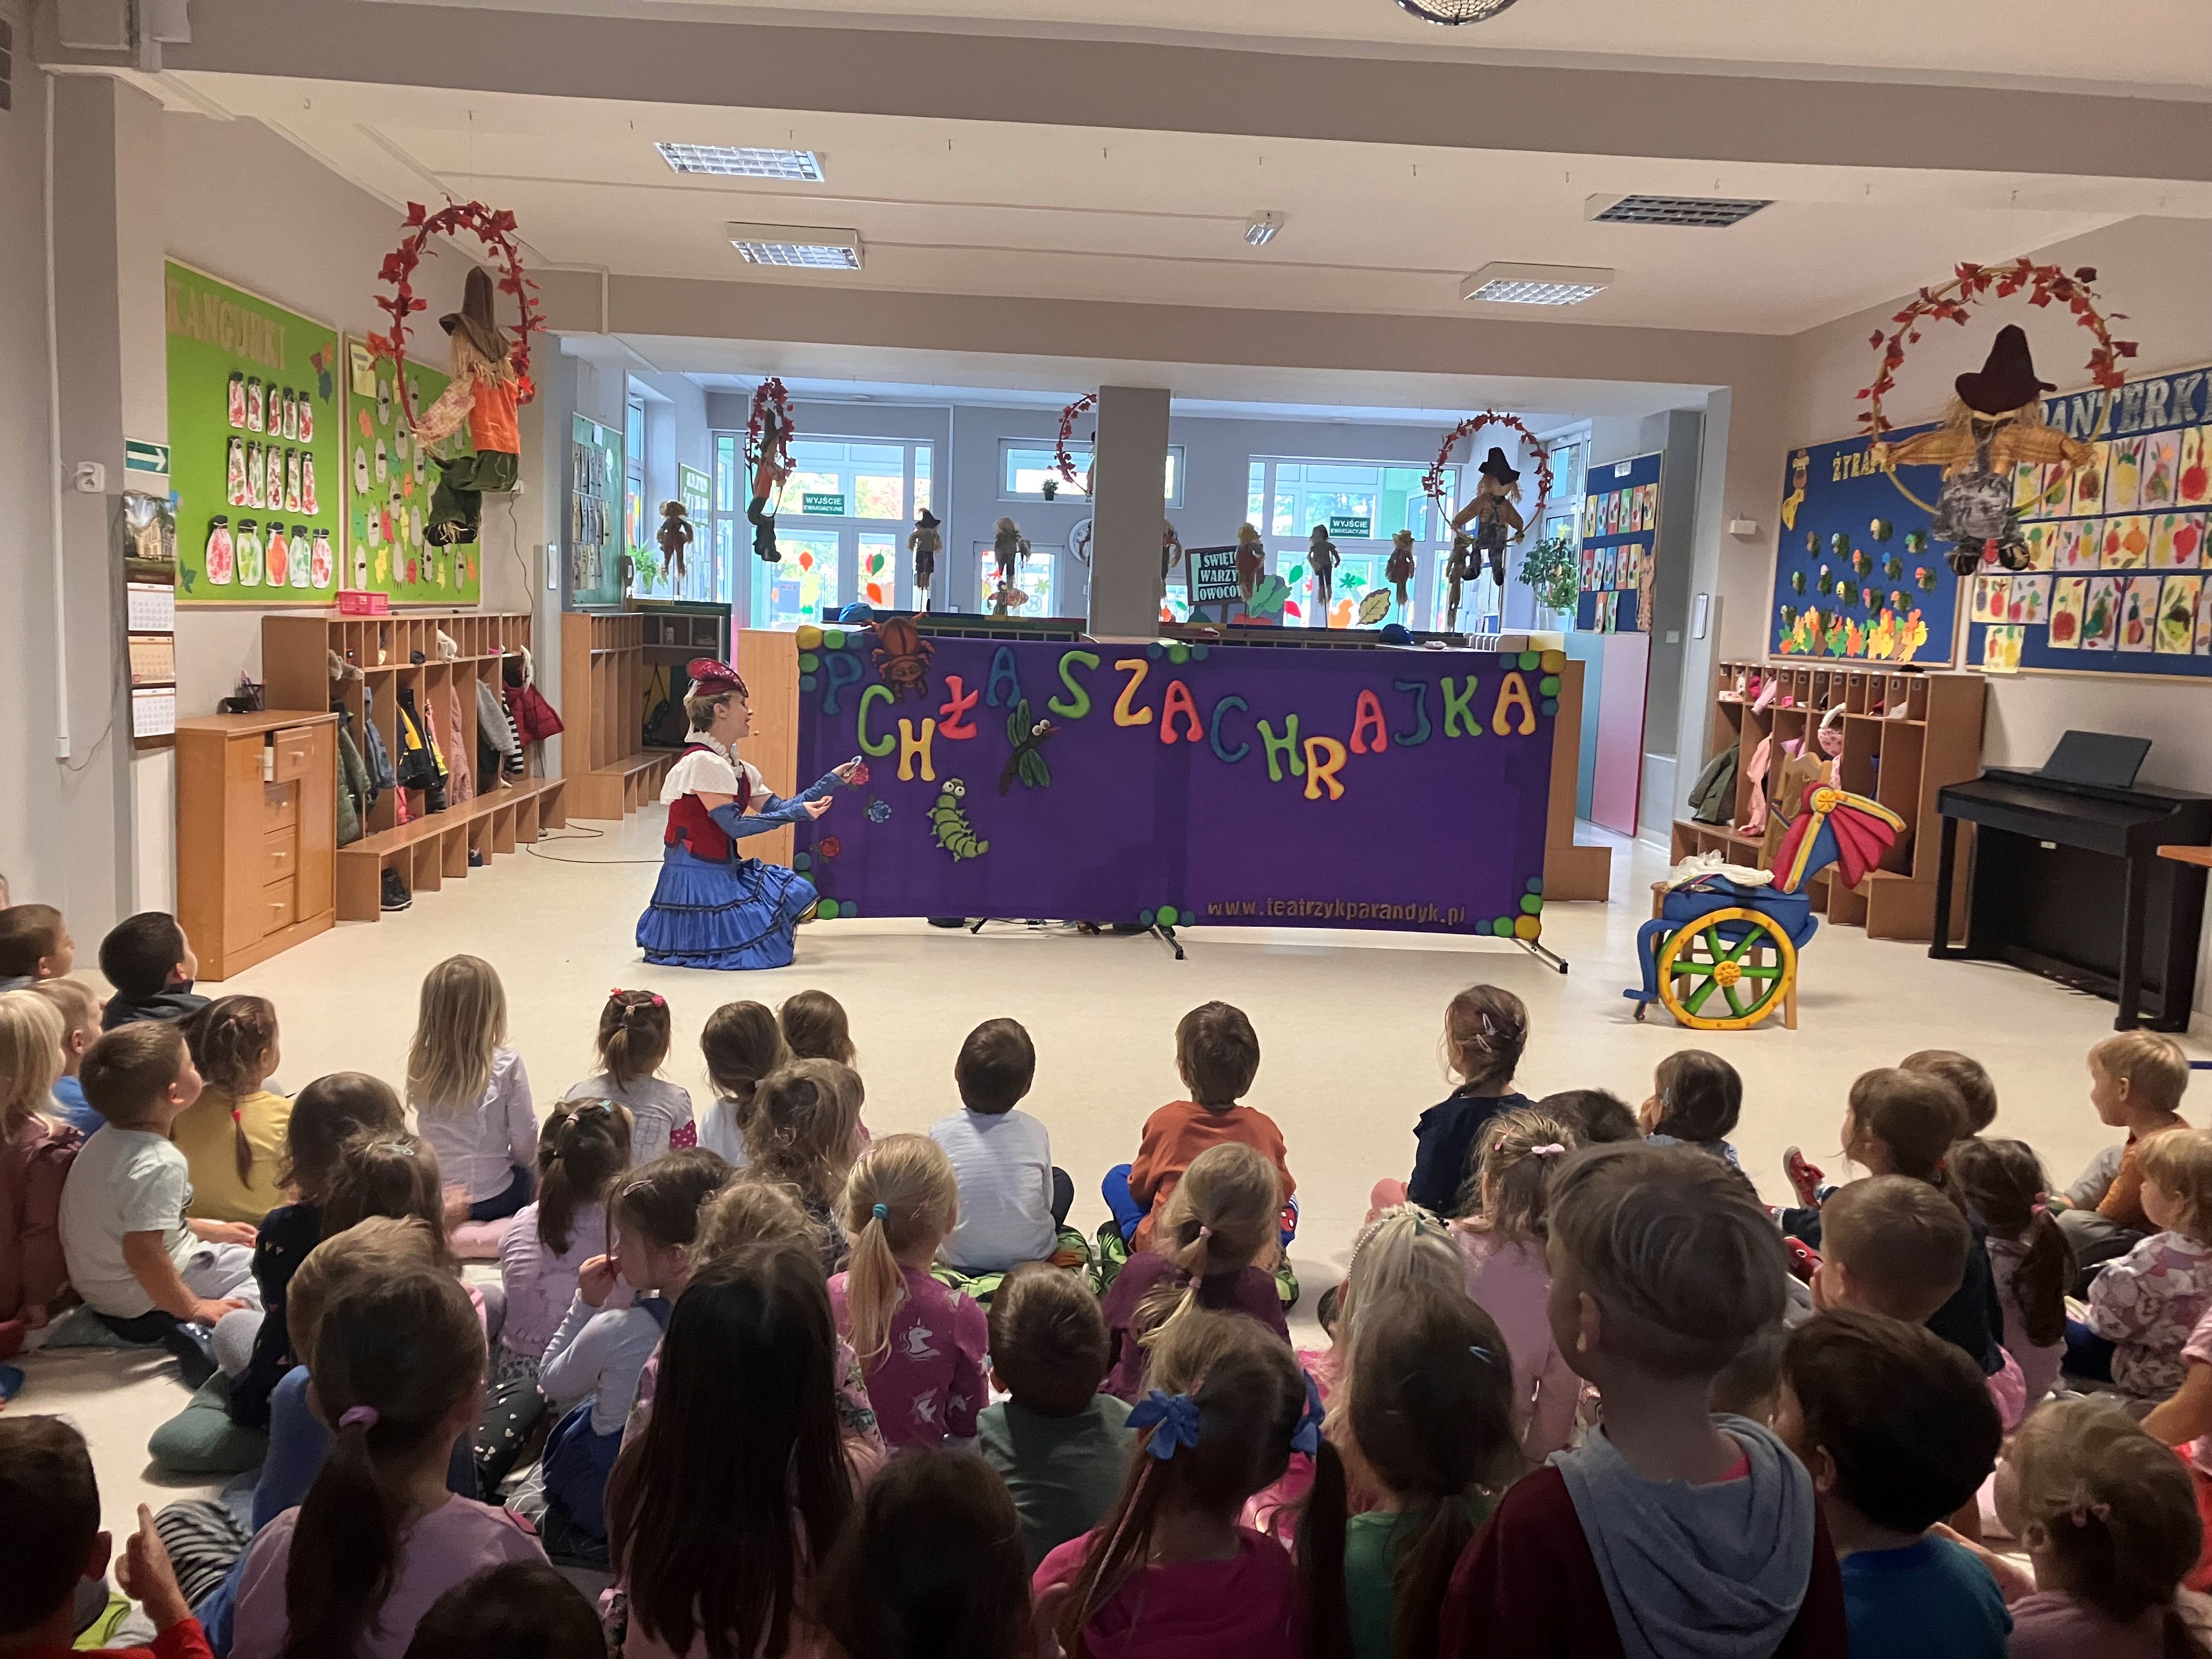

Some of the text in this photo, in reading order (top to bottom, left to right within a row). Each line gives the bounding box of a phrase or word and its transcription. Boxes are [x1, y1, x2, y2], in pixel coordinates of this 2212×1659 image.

[805, 496, 842, 505] WYJŚCIE
[1333, 519, 1367, 528] WYJŚCIE
[822, 645, 1536, 800] PCHŁA SZACHRAJKA
[1207, 898, 1465, 926] www.teatrzykparandyk.pl
